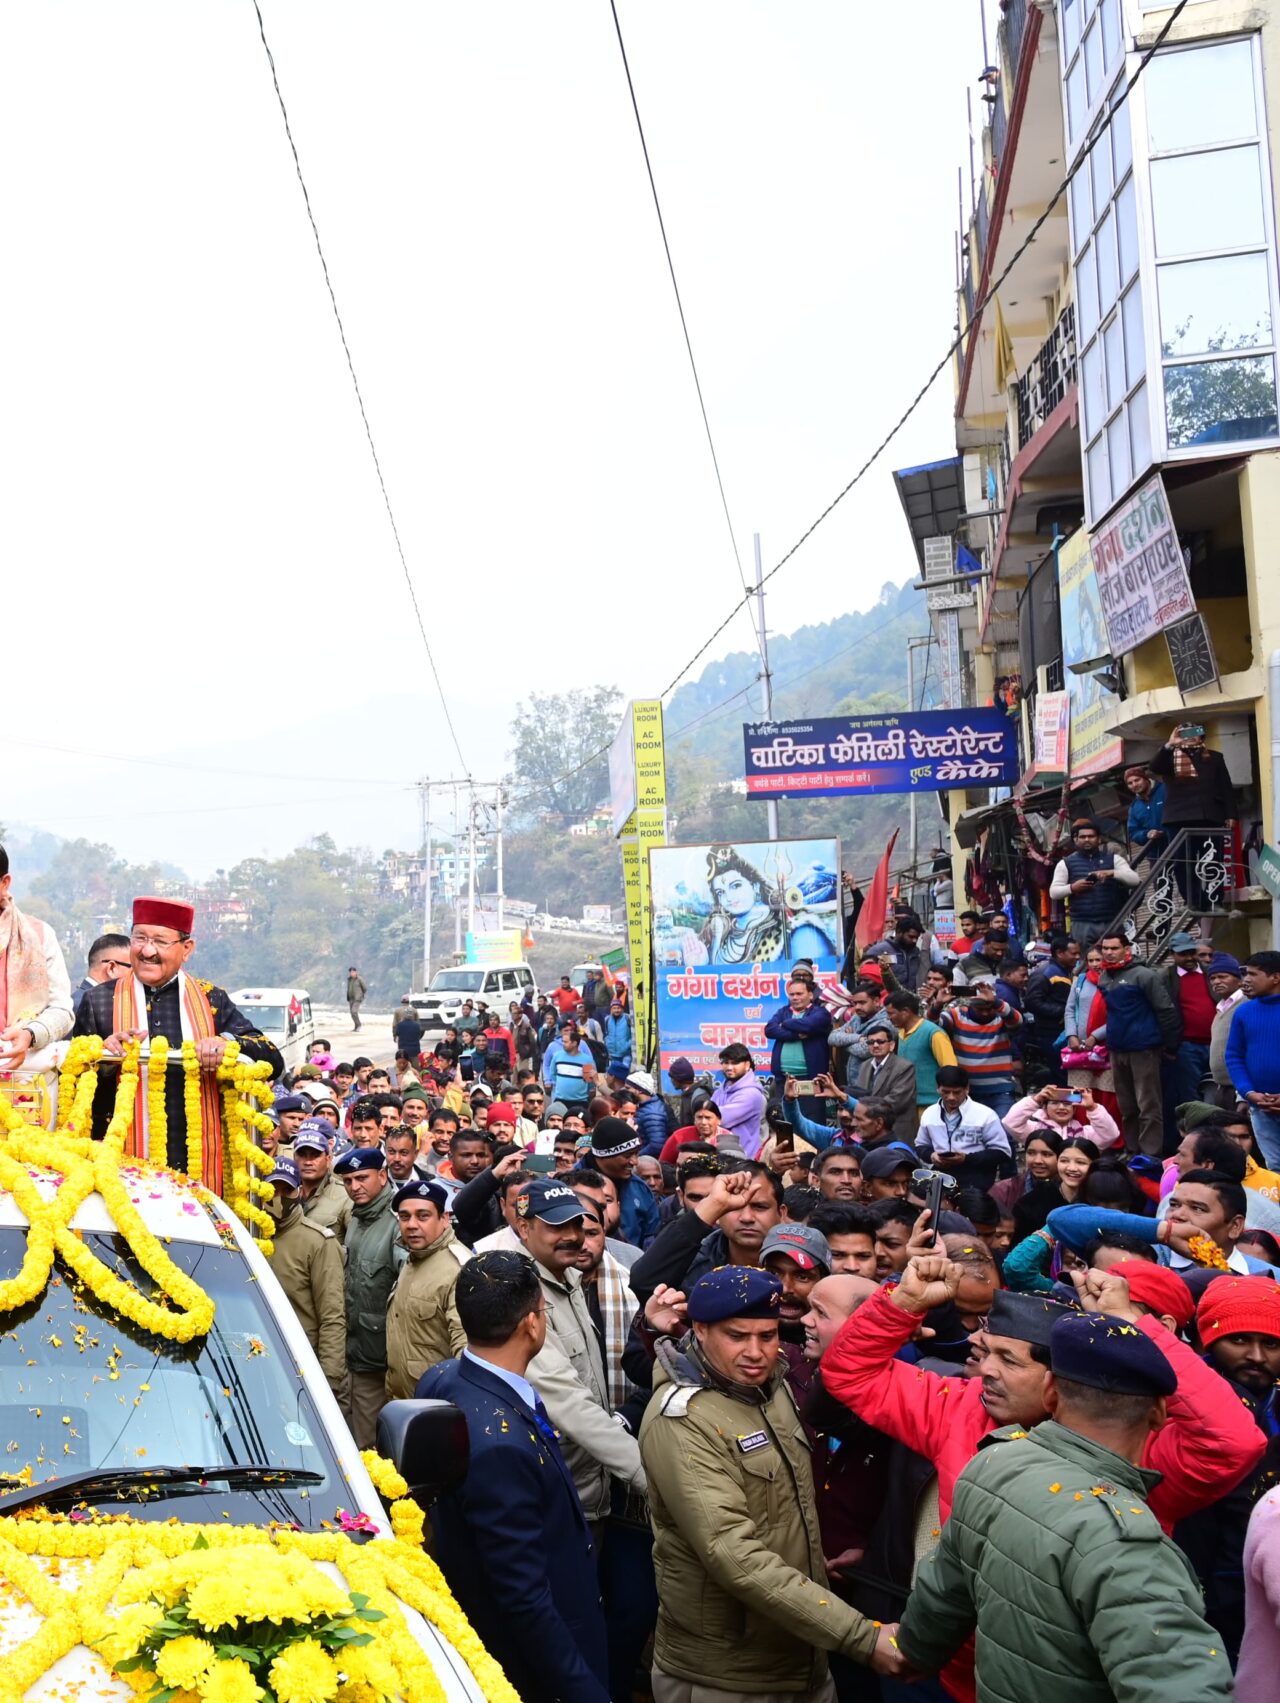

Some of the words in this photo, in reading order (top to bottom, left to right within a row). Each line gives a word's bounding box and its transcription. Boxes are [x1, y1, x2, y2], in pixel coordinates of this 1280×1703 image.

[635, 706, 658, 714] LUXURY
[642, 731, 654, 739] AC
[636, 742, 661, 750] ROOM
[751, 737, 826, 768] वाटिका
[637, 761, 661, 769] LUXURY
[645, 787, 657, 795] AC
[639, 798, 664, 806] ROOM
[640, 830, 664, 838] ROOM
[668, 967, 718, 999] गंगा
[722, 964, 780, 999] दर्शन
[744, 1005, 763, 1019] एवं
